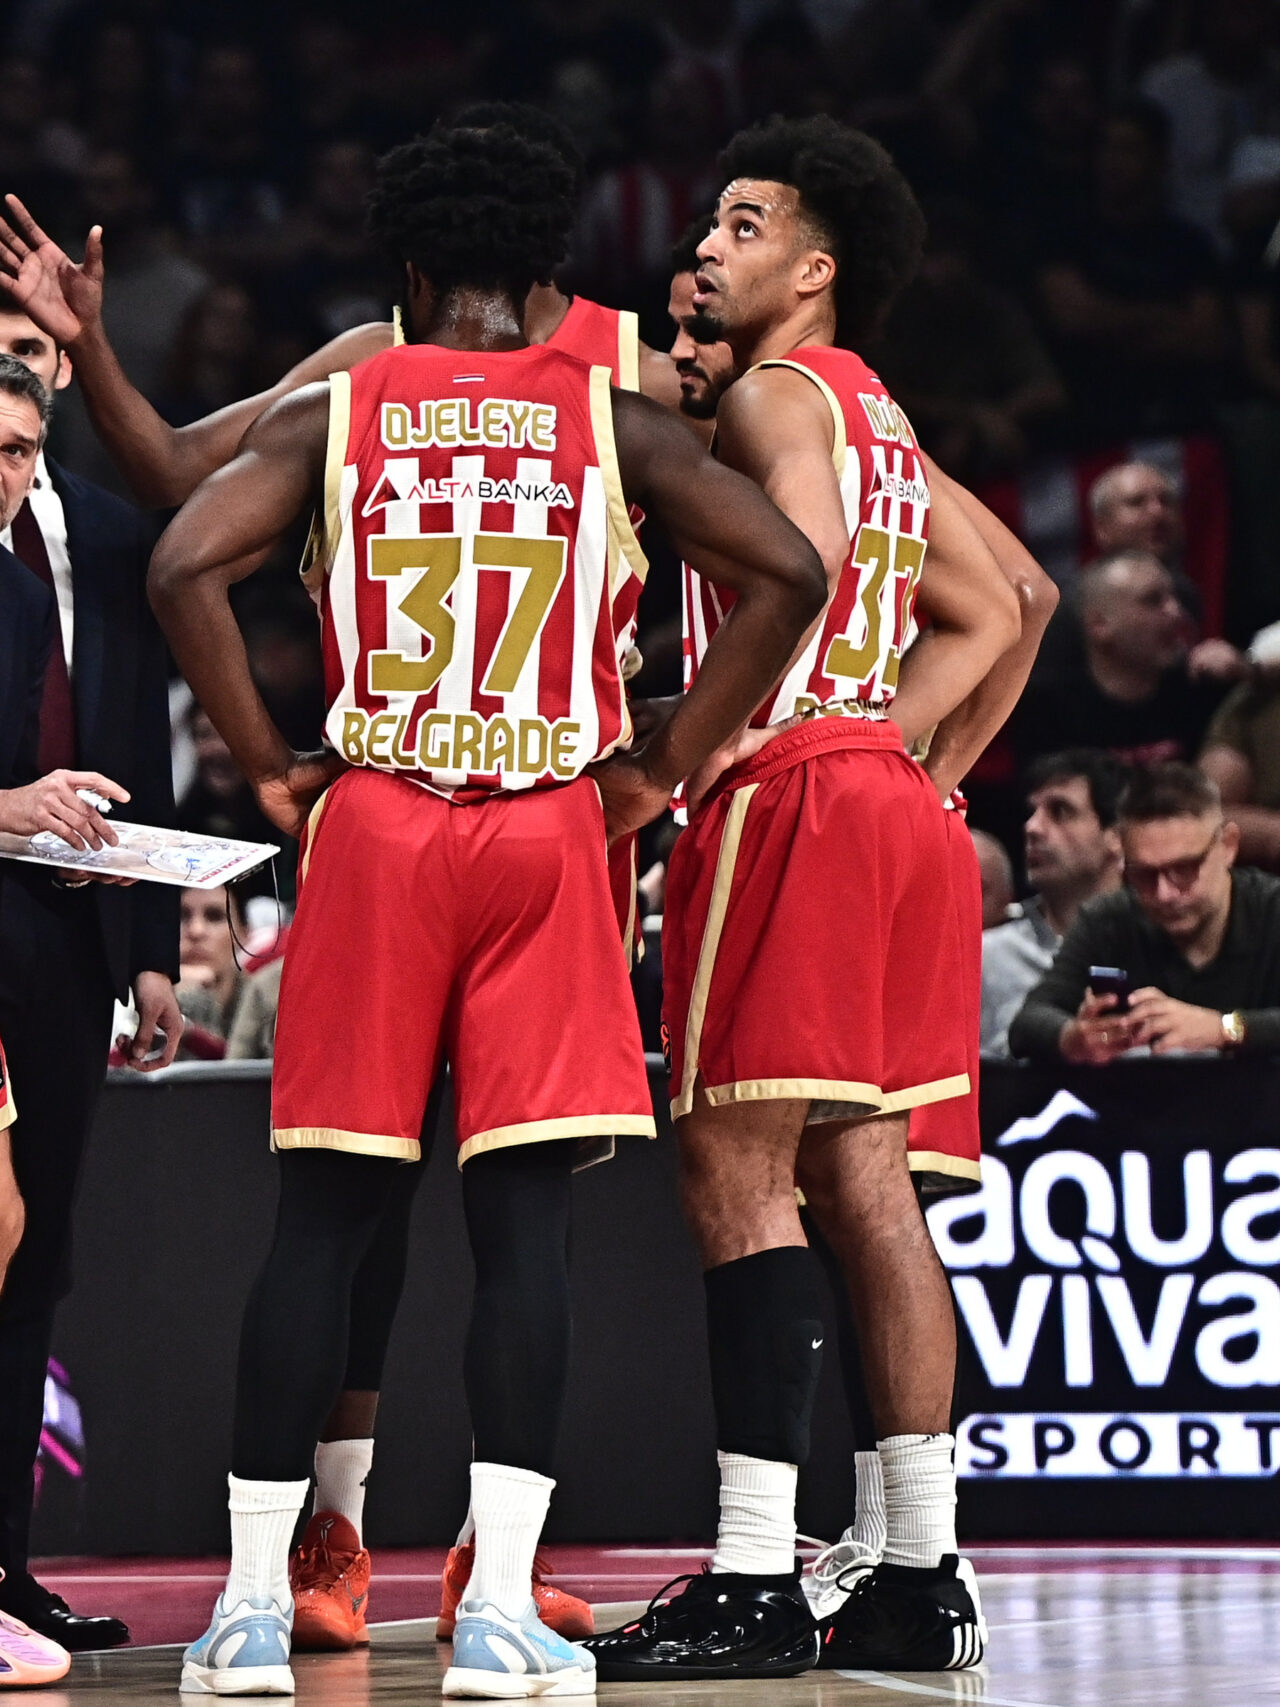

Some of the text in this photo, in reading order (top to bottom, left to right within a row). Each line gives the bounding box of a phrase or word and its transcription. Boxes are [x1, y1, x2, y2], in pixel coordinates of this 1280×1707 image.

[370, 534, 566, 694] 37
[341, 710, 581, 777] BELGRADE
[951, 1271, 1280, 1389] viva
[967, 1419, 1280, 1471] SPORT
